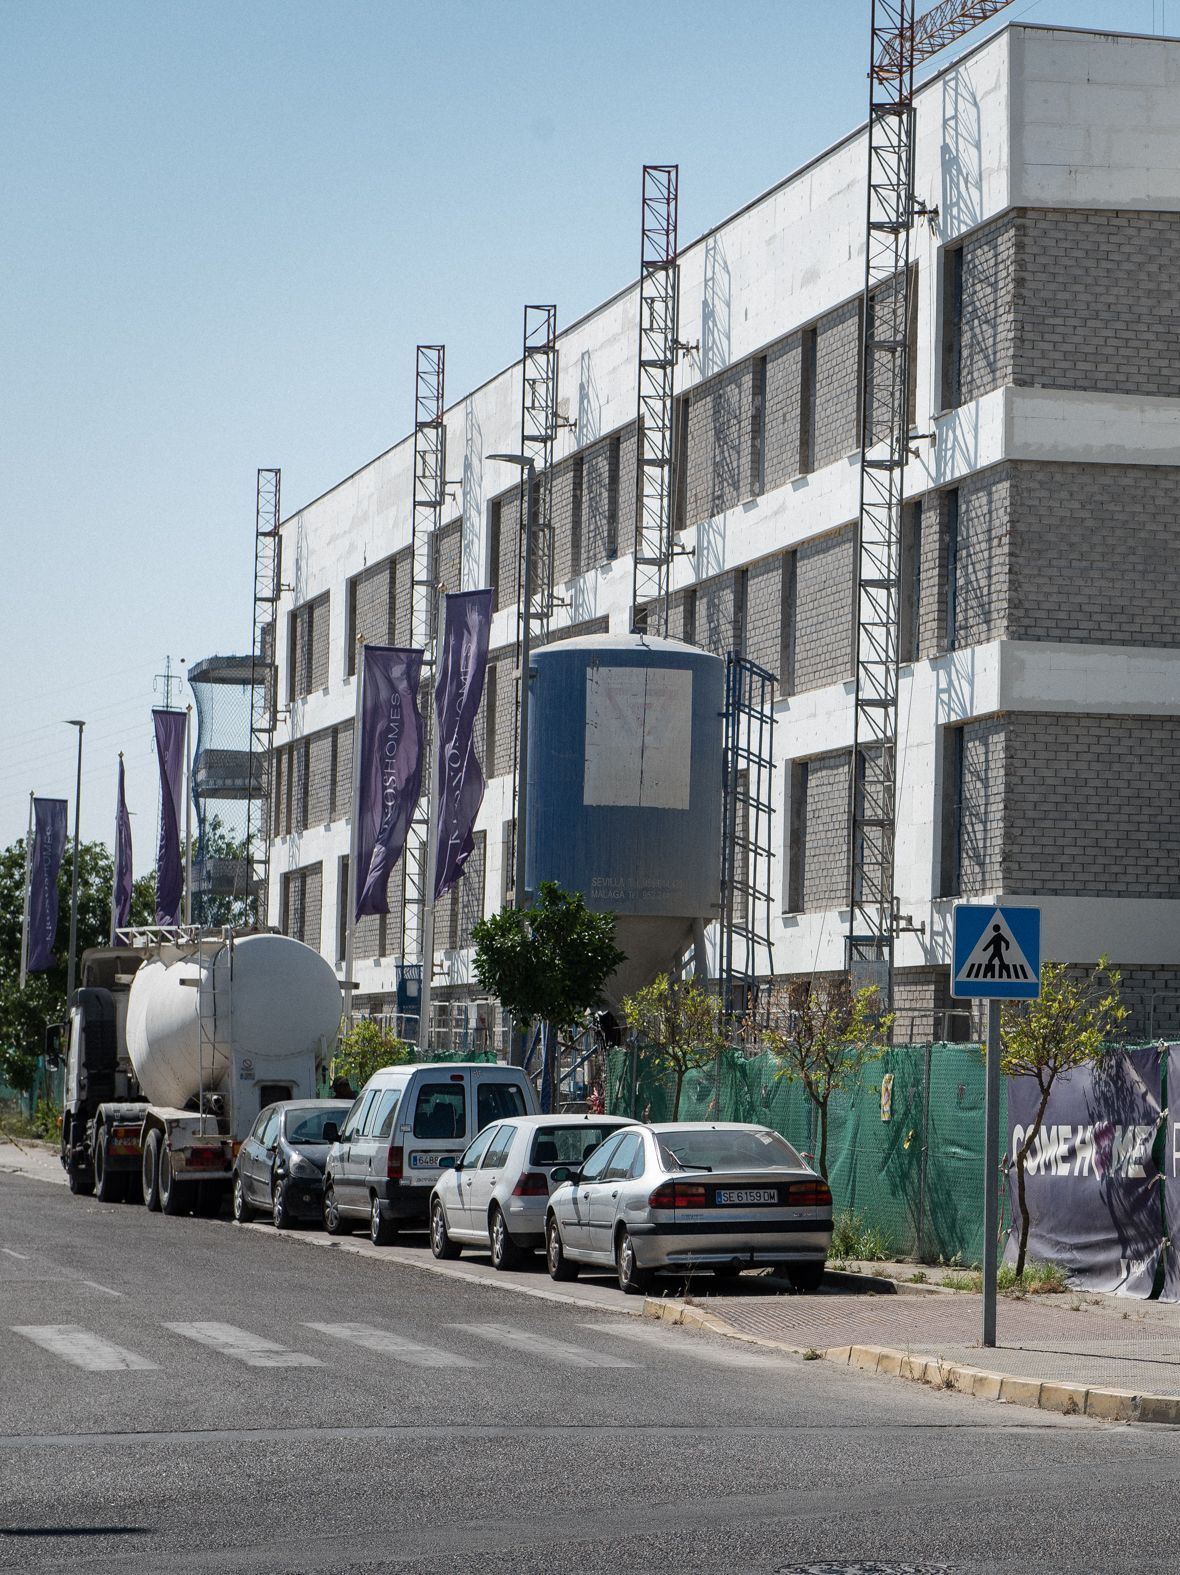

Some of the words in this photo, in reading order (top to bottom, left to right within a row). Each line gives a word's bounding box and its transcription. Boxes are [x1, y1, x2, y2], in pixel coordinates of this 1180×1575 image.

[1012, 1123, 1073, 1176] COME
[722, 1191, 735, 1202] SE
[737, 1191, 761, 1202] 6159
[763, 1191, 776, 1201] DM
